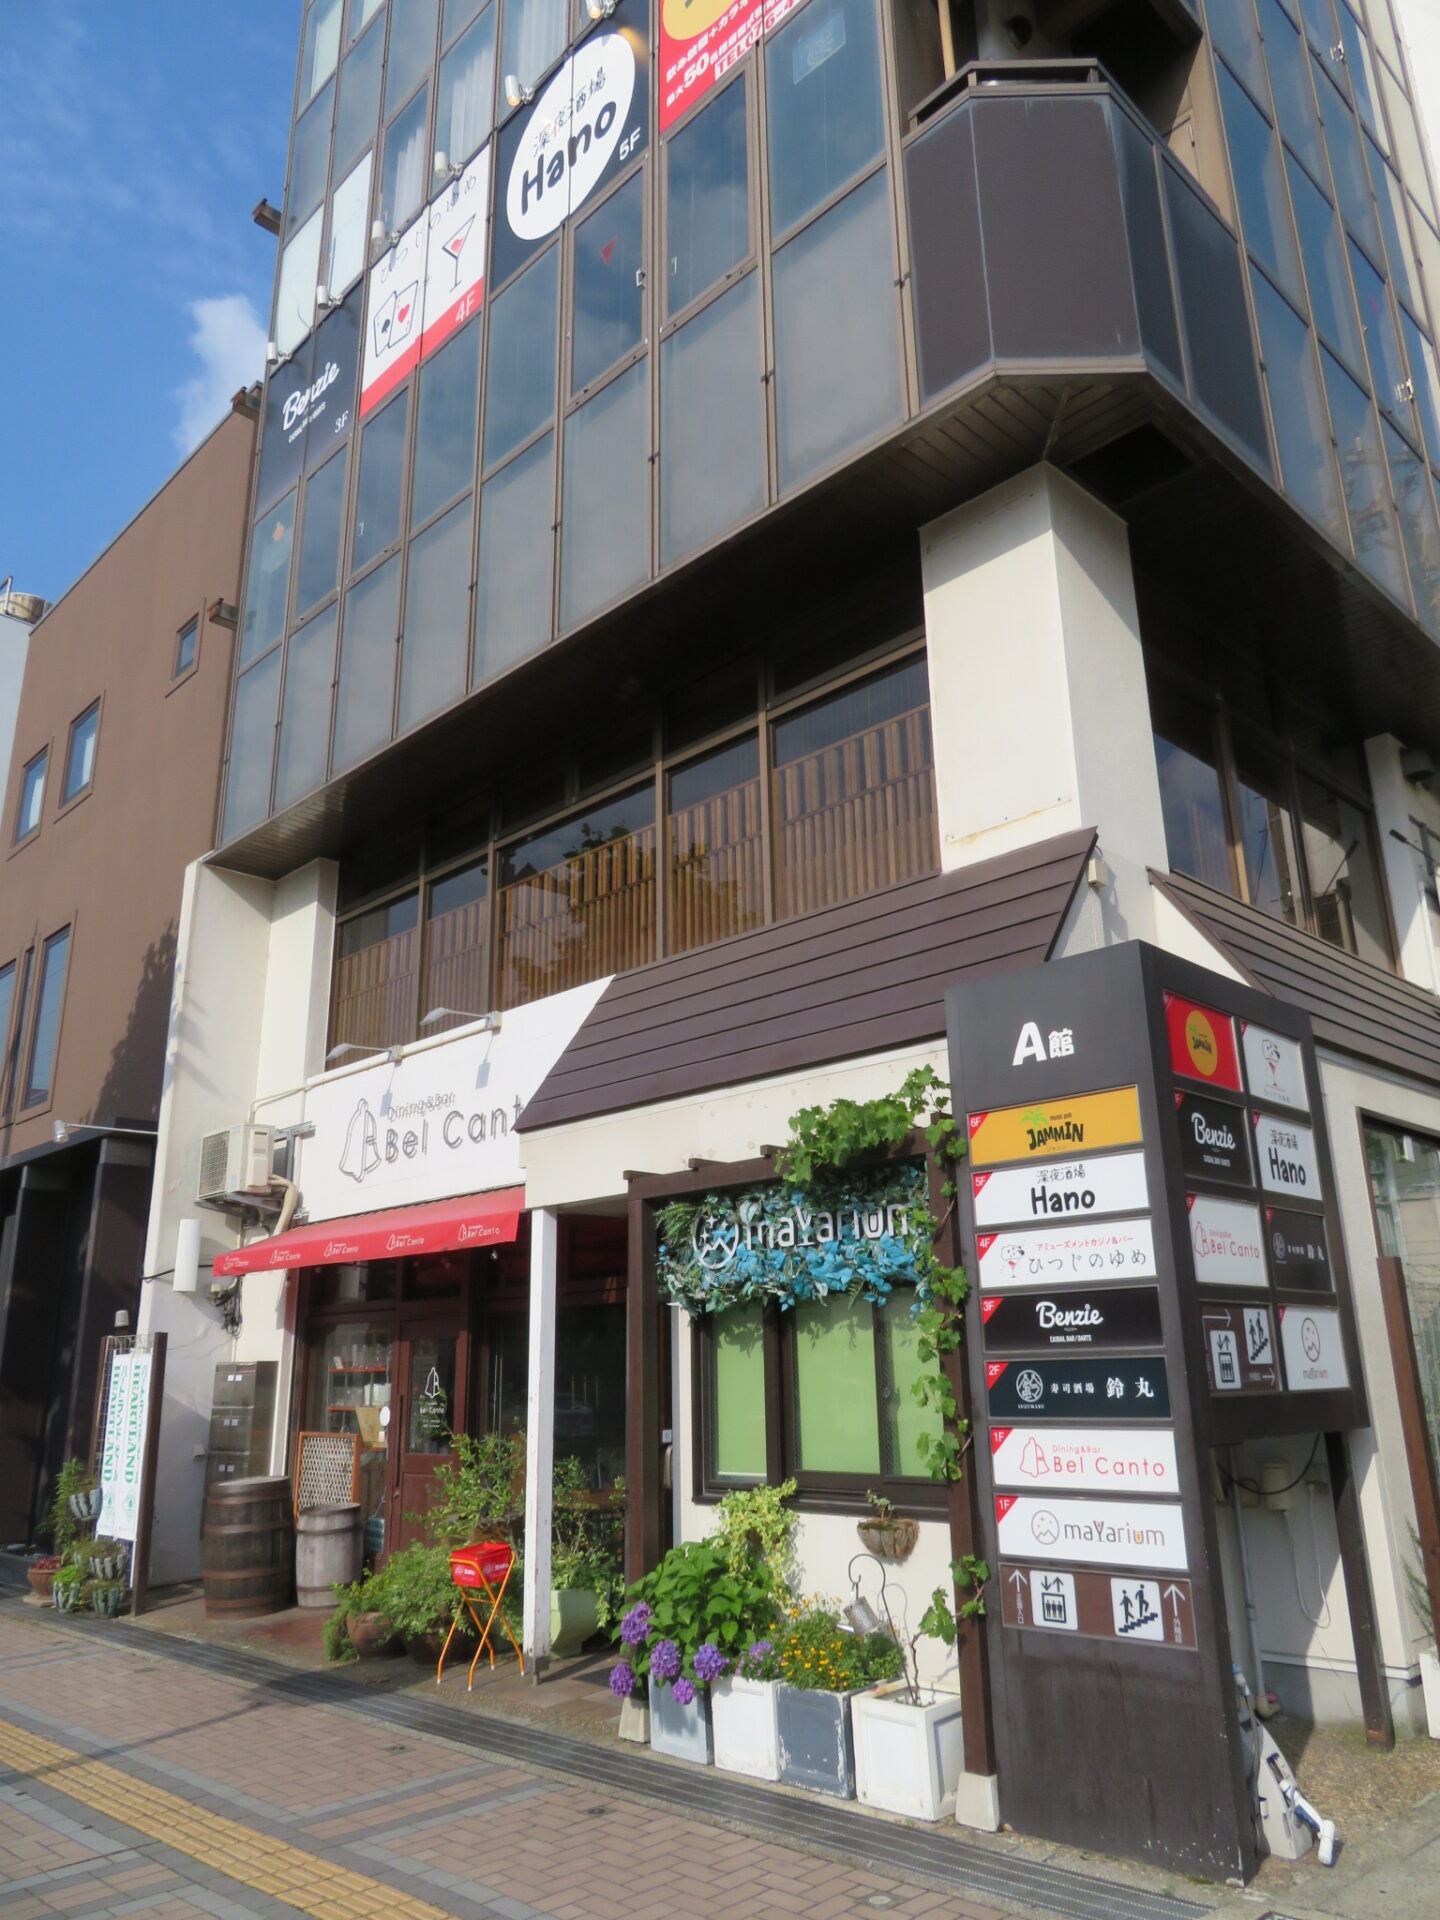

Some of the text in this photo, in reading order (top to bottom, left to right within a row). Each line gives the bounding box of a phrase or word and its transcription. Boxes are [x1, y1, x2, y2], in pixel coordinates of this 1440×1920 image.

[619, 127, 641, 160] 5F
[521, 101, 617, 216] Hano
[381, 176, 477, 284] ひつじのゆめ
[455, 290, 475, 322] 4F
[283, 362, 340, 431] Benzie
[335, 410, 349, 433] 3F
[1012, 1021, 1075, 1067] A館
[385, 1095, 525, 1163] Bel Cant
[970, 1117, 981, 1127] 6F
[1191, 1112, 1236, 1150] Benzie
[1026, 1121, 1084, 1150] JAMMIN
[1036, 1163, 1085, 1184] 深夜酒場
[1268, 1147, 1306, 1186] Hano
[975, 1176, 986, 1187] 5F
[1030, 1185, 1096, 1215] Hano
[478, 1227, 500, 1237] Canto
[979, 1237, 991, 1248] 4F
[1210, 1238, 1260, 1259] Bel Canto
[1028, 1249, 1147, 1274] ひつじのゆめ
[983, 1300, 995, 1311] 3F
[1035, 1301, 1104, 1328] Benzie
[988, 1364, 1000, 1376] 2F
[1050, 1381, 1095, 1395] 寿司酒場
[1106, 1377, 1155, 1399] 鈴丸
[103, 1365, 121, 1482] HEARTLAND
[124, 1364, 141, 1484] HEARTLAND
[993, 1432, 1005, 1442] 1F
[1052, 1444, 1101, 1455] Dining&Bar
[1053, 1455, 1165, 1477] Bel Canto
[999, 1499, 1010, 1511] 1F
